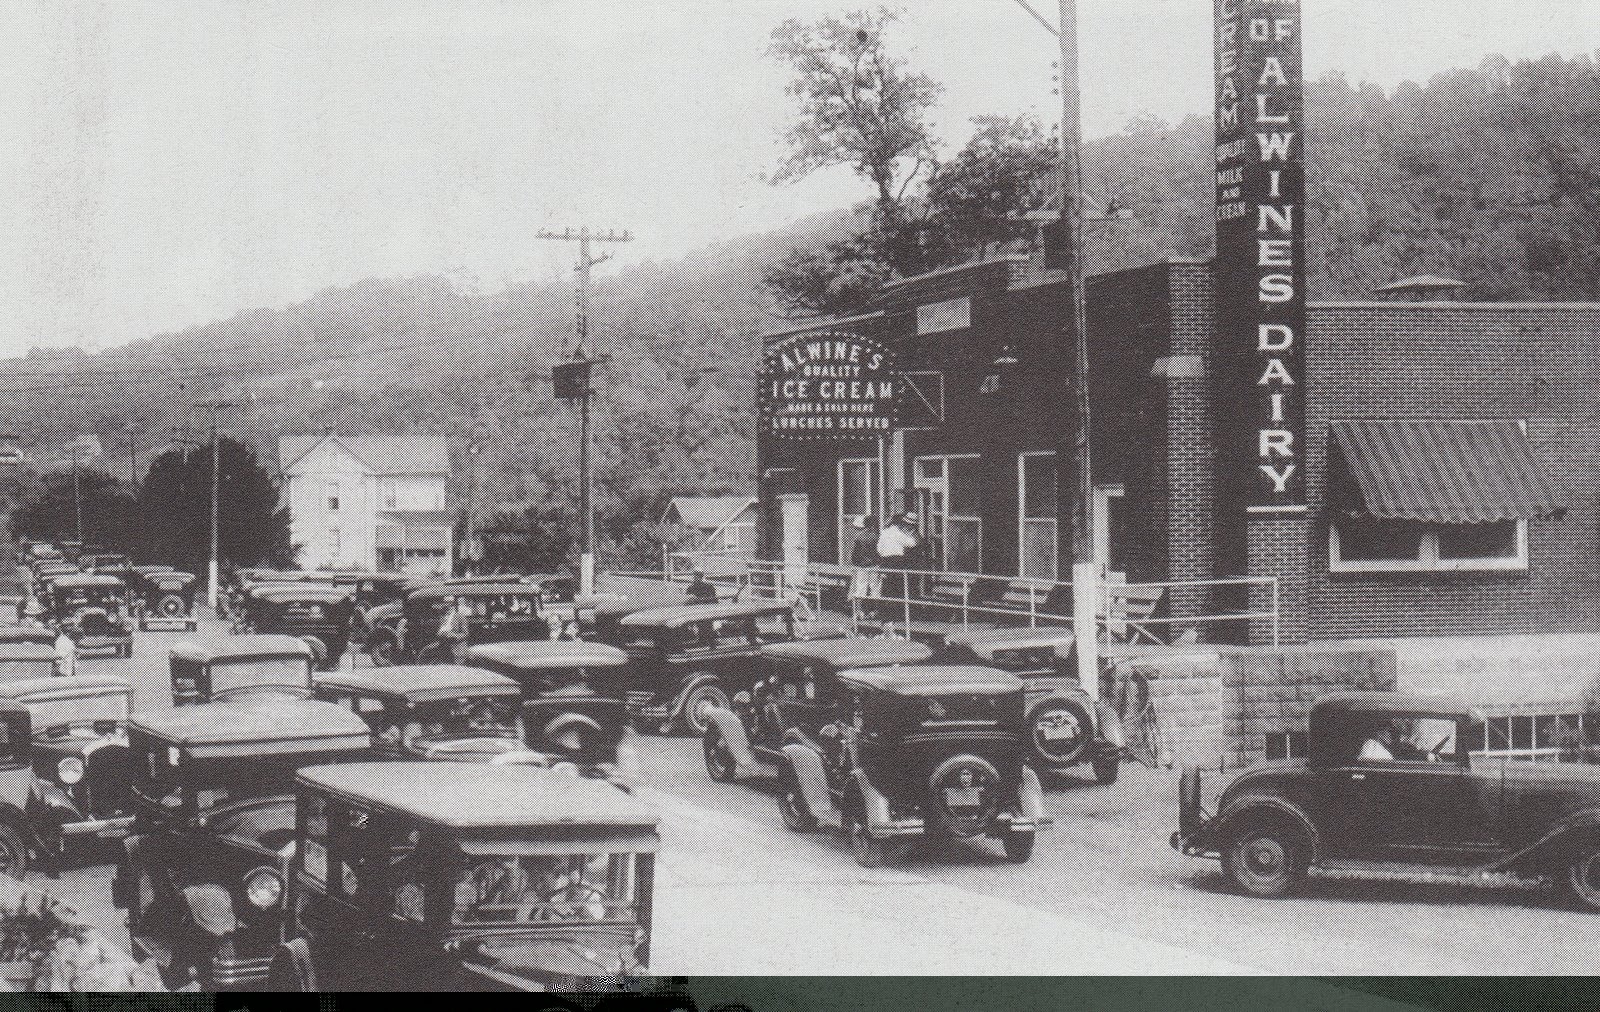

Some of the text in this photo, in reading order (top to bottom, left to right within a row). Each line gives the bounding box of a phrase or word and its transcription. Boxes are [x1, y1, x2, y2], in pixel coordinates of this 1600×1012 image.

[1250, 18, 1293, 41] OF
[1216, 166, 1244, 186] MILK
[1256, 56, 1295, 492] ALWINES DAIRY
[781, 341, 883, 372] ALWINE'S
[803, 365, 861, 378] QUALITY
[772, 381, 893, 400] ICE CREAM
[771, 417, 890, 429] LUNCHES SERVED
